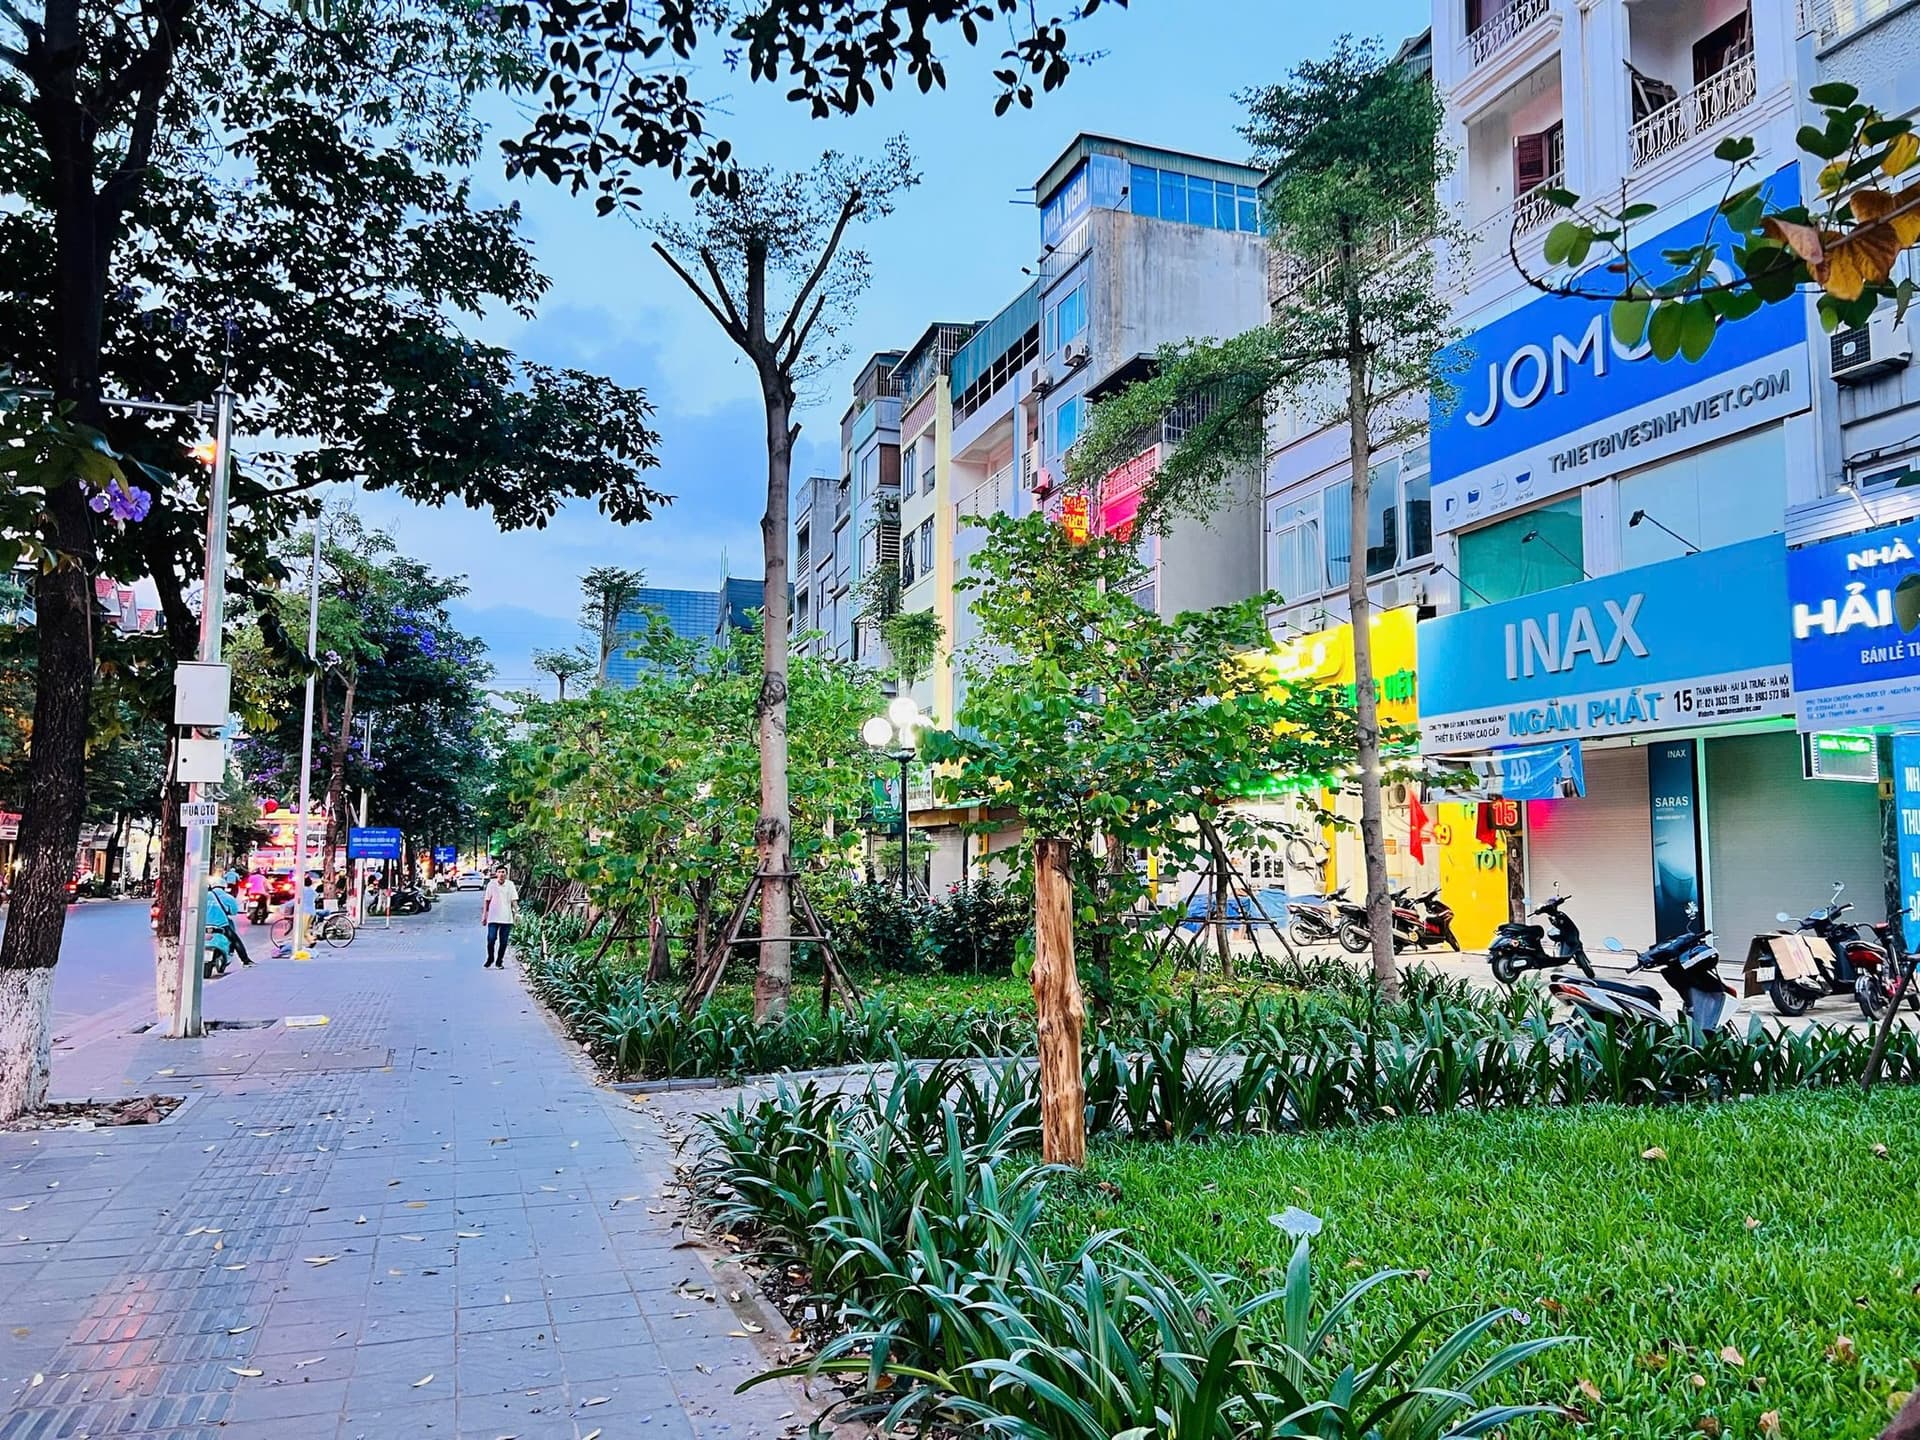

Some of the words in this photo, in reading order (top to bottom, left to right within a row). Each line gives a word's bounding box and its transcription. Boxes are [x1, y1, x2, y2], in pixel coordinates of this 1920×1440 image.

[1548, 368, 1790, 474] THIETBIVESINHVIET.COM
[1847, 537, 1915, 571] NHÀ
[1793, 582, 1893, 639] HẢI
[1505, 593, 1649, 679] INAX
[1861, 646, 1887, 664] BÁN
[1587, 688, 1664, 727] PHÁT
[1674, 689, 1693, 712] 15
[1476, 728, 1488, 739] CAO
[1667, 749, 1687, 758] INAX
[1492, 801, 1518, 826] 15
[1655, 795, 1689, 808] SARAS
[1473, 848, 1505, 871] TỐT
